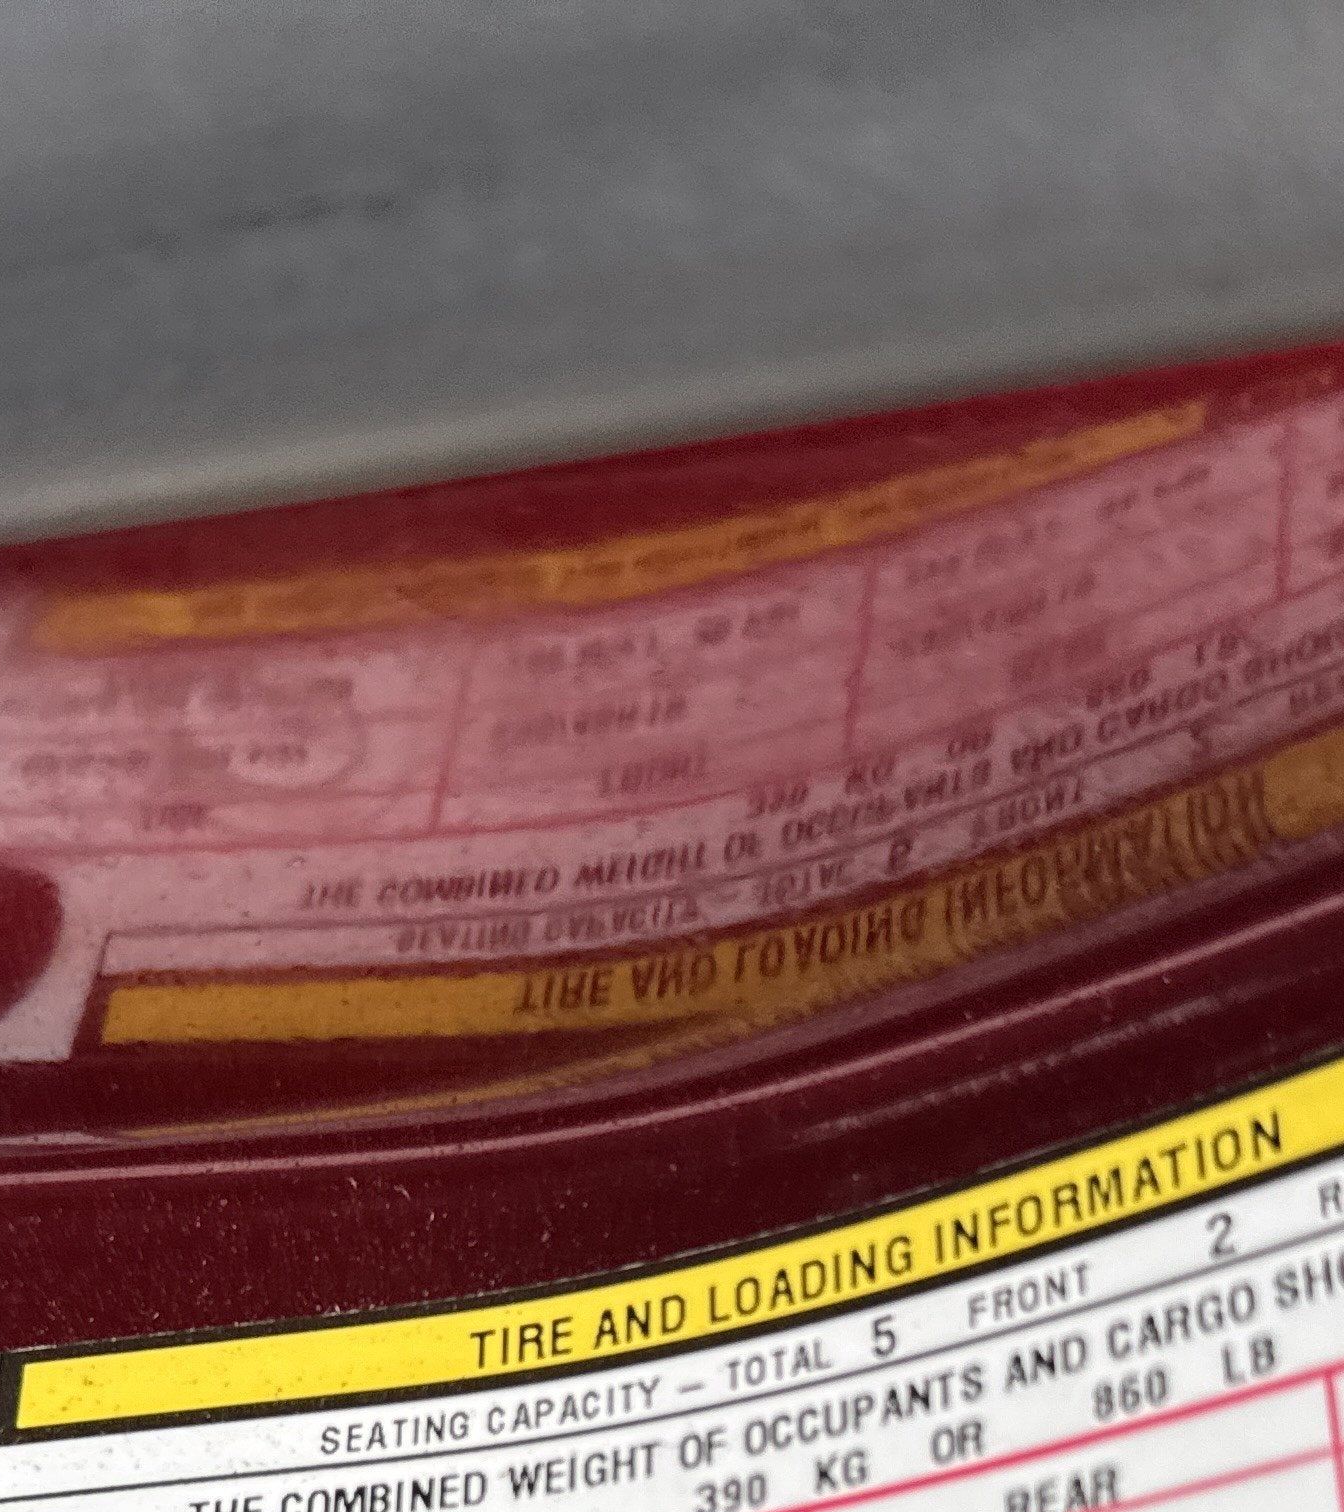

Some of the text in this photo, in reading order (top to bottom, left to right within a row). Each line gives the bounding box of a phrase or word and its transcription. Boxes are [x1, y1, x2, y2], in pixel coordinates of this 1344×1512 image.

[321, 1412, 470, 1455] SEATING
[487, 1378, 662, 1436] CAPACITY
[726, 1340, 831, 1392] TOTAL
[870, 1314, 898, 1360] 5
[966, 1262, 1094, 1328] FRONT
[1205, 1211, 1236, 1257] 2
[470, 1109, 1287, 1370] TIRE AND LOADING INFORMATION
[507, 1441, 662, 1497] WEIGHT
[678, 1425, 726, 1470] OF
[743, 1366, 984, 1456] OCCUPANTS
[1005, 1331, 1088, 1391] AND
[1107, 1281, 1256, 1359] CARGO
[813, 1450, 870, 1494] KG
[931, 1419, 985, 1463] OR
[1092, 1367, 1168, 1420] 860
[1221, 1331, 1277, 1386] LB
